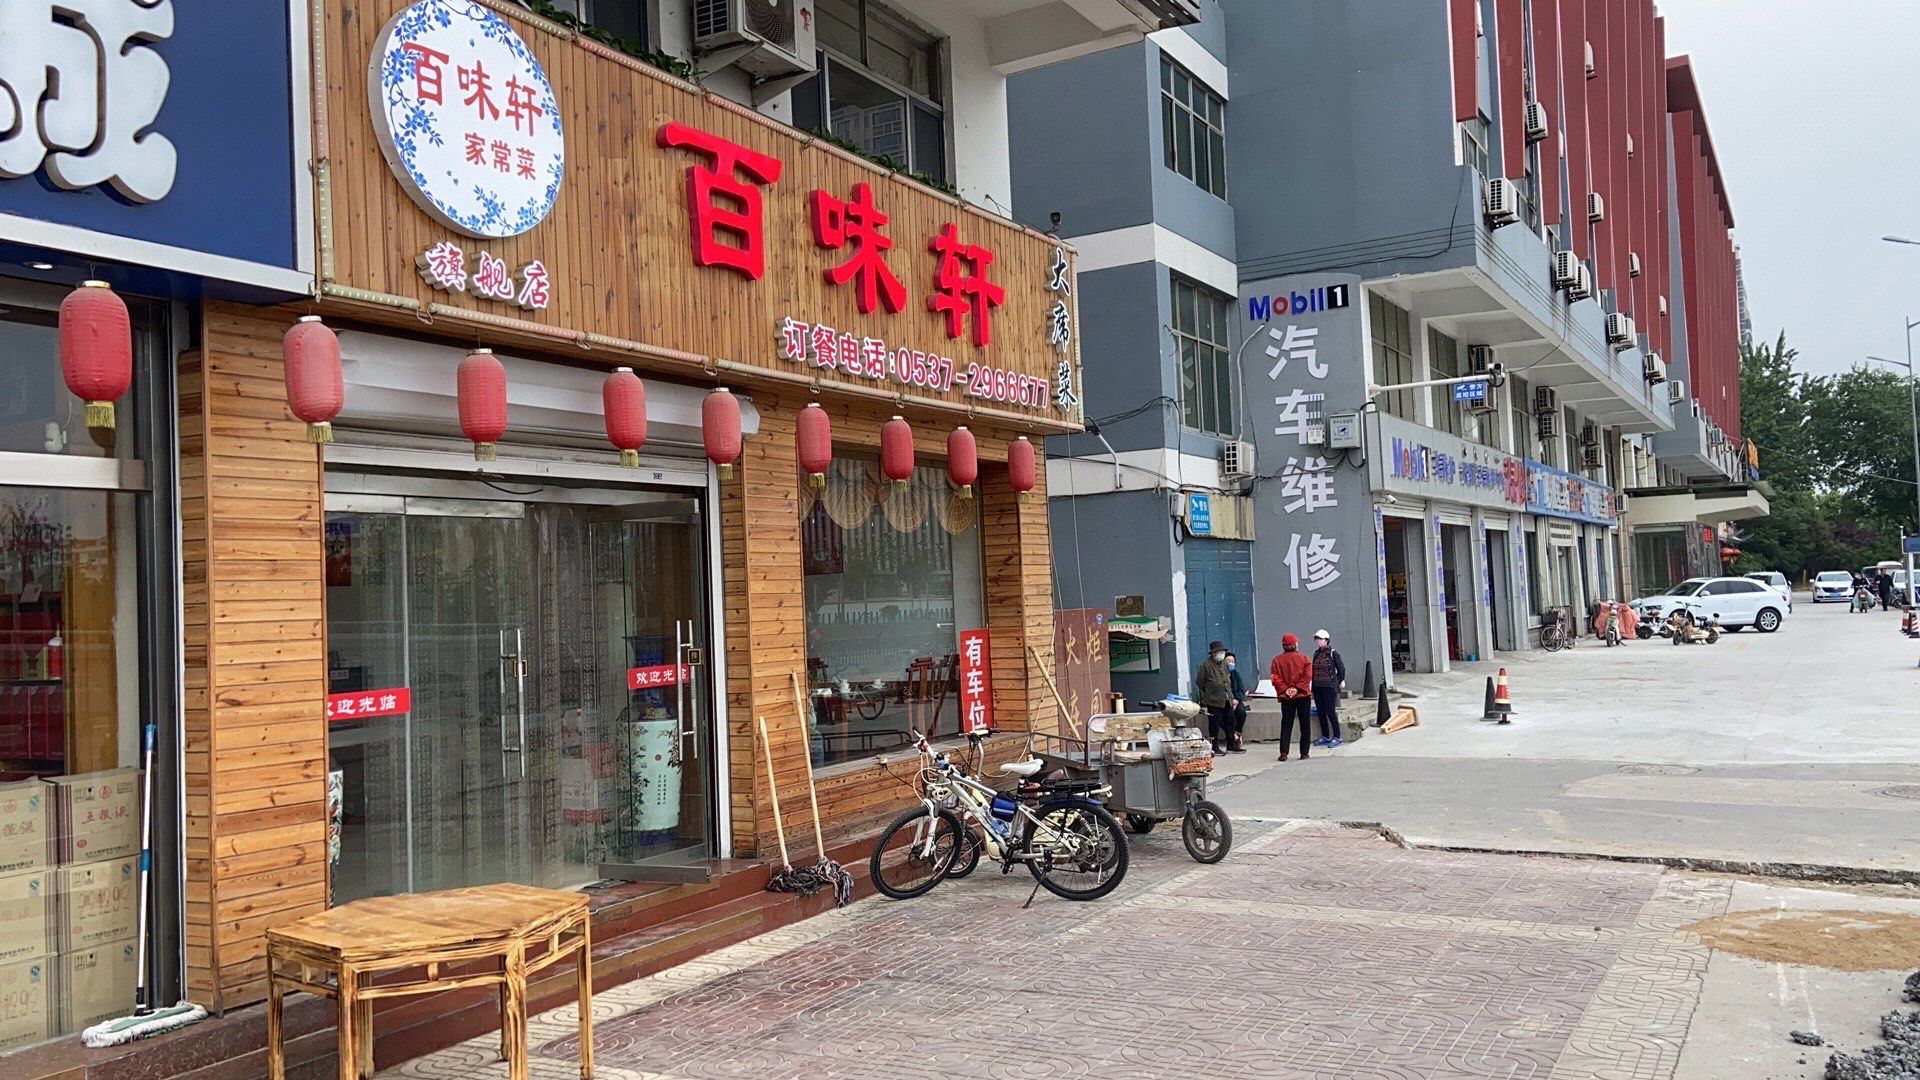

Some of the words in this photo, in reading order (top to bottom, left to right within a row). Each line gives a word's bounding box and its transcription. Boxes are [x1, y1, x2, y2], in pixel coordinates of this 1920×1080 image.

[403, 42, 543, 137] 百味轩
[465, 132, 536, 181] 家常菜
[425, 242, 550, 308] 旗舰店
[656, 120, 1006, 347] 百味轩
[1050, 246, 1078, 413] 大席菜
[1265, 325, 1341, 592] 汽车维修
[965, 635, 987, 733] 有车位
